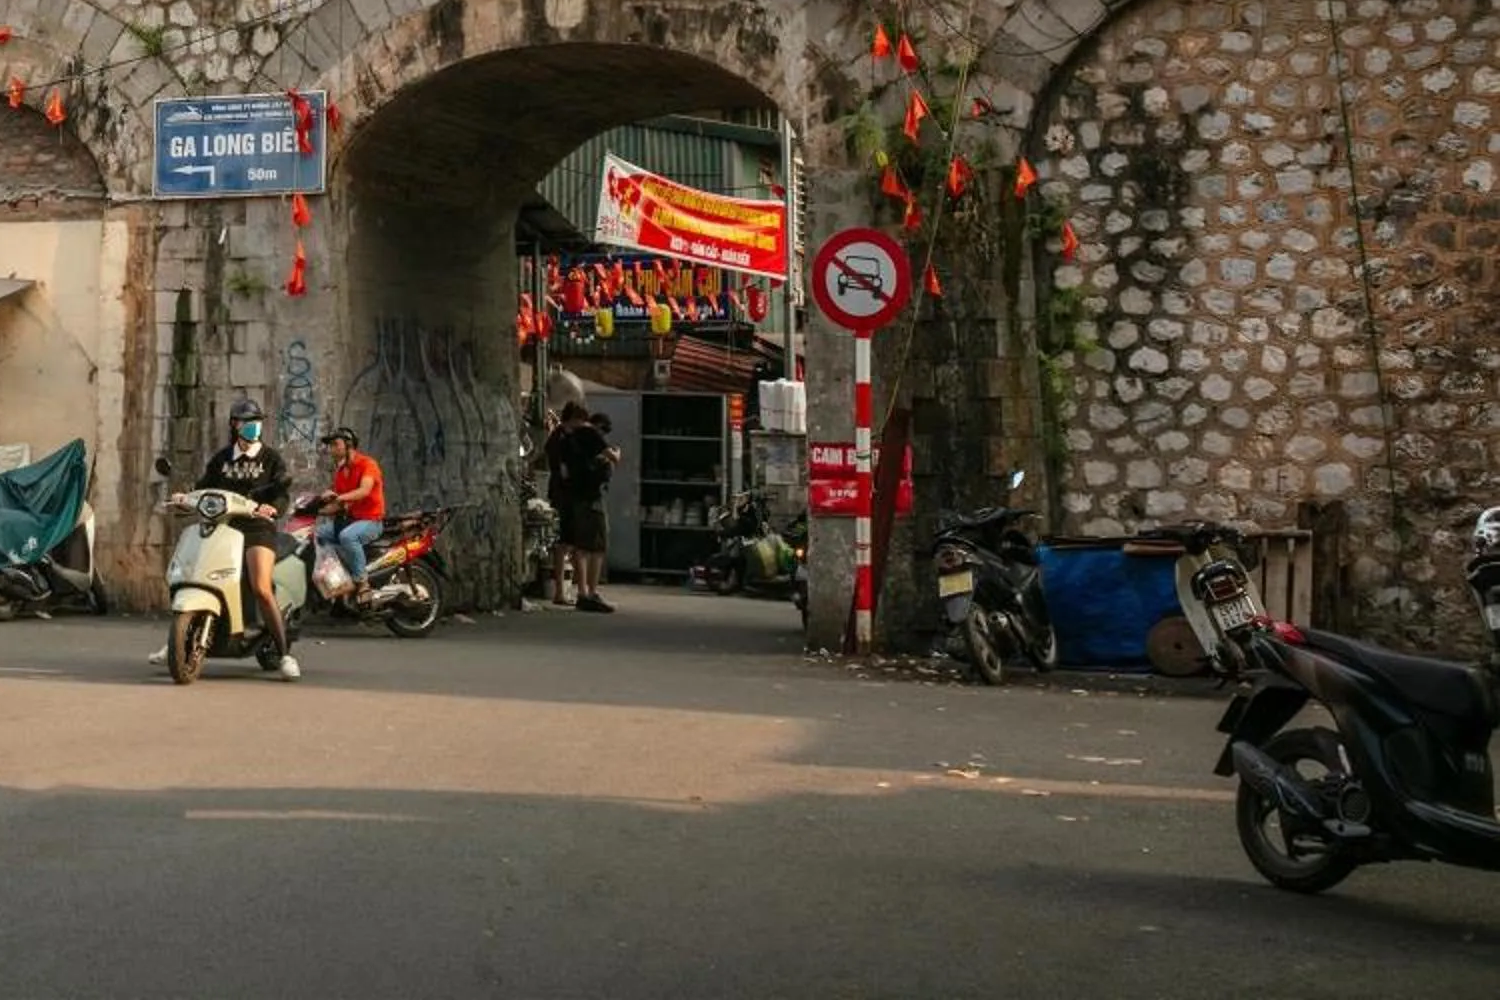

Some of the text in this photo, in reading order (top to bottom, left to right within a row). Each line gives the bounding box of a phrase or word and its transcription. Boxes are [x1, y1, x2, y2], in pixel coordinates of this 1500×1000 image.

[169, 136, 197, 158] GA
[203, 133, 255, 157] LONG
[247, 168, 278, 182] 50m
